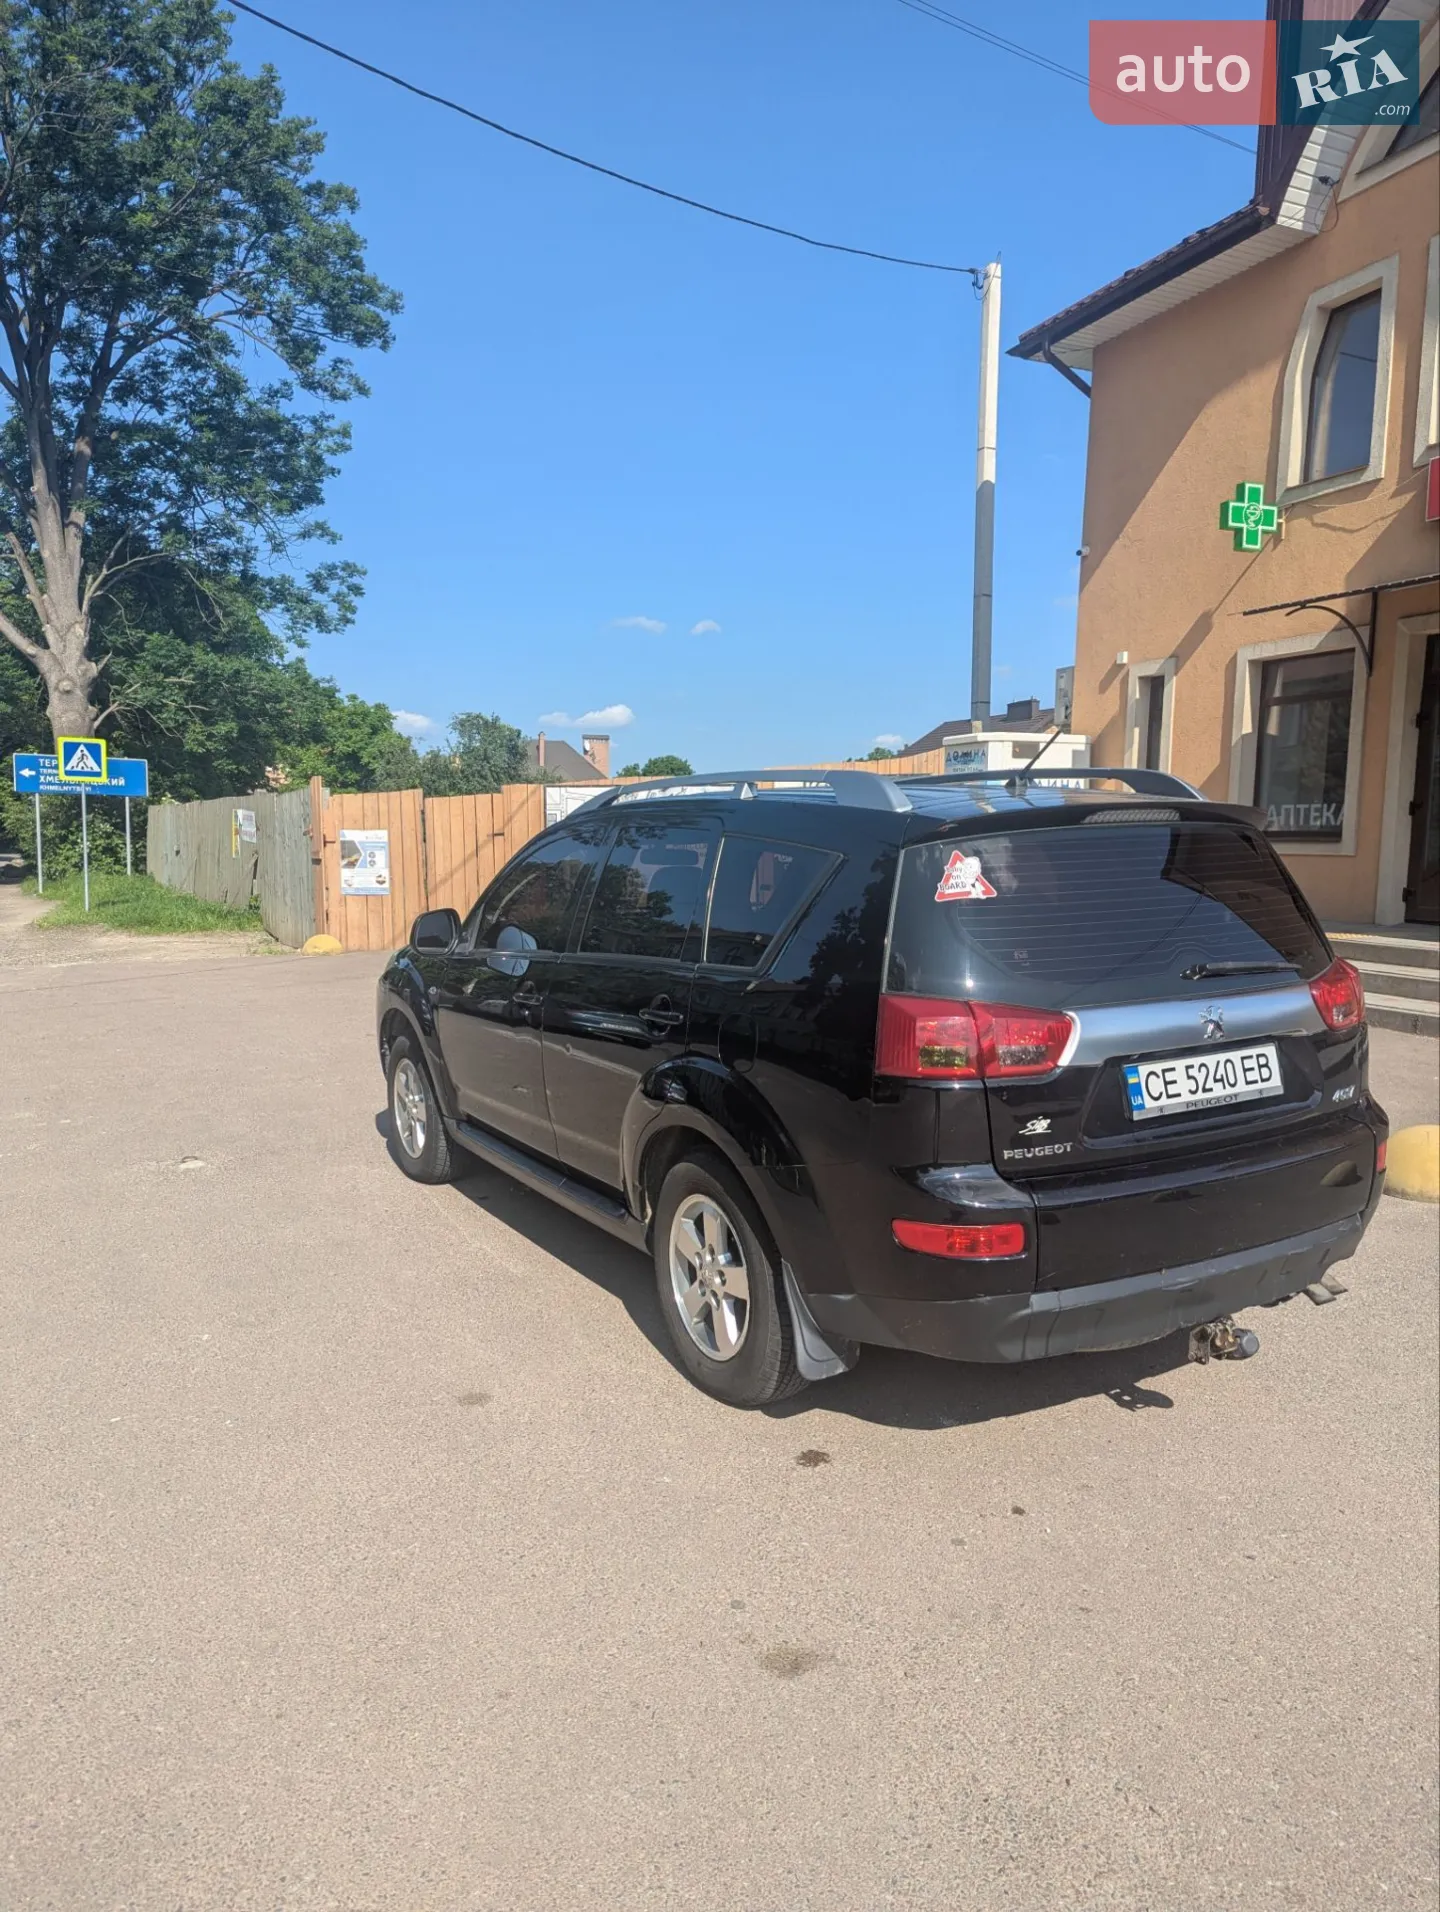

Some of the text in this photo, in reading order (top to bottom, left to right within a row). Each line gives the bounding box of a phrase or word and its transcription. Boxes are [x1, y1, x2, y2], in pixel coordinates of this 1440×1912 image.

[38, 758, 58, 767] ТЕР
[1145, 1052, 1273, 1102] CE 5240 EB
[1131, 1096, 1144, 1106] UA
[1185, 1093, 1241, 1110] PEUGEOT
[1002, 1141, 1074, 1161] PEUGEOT
